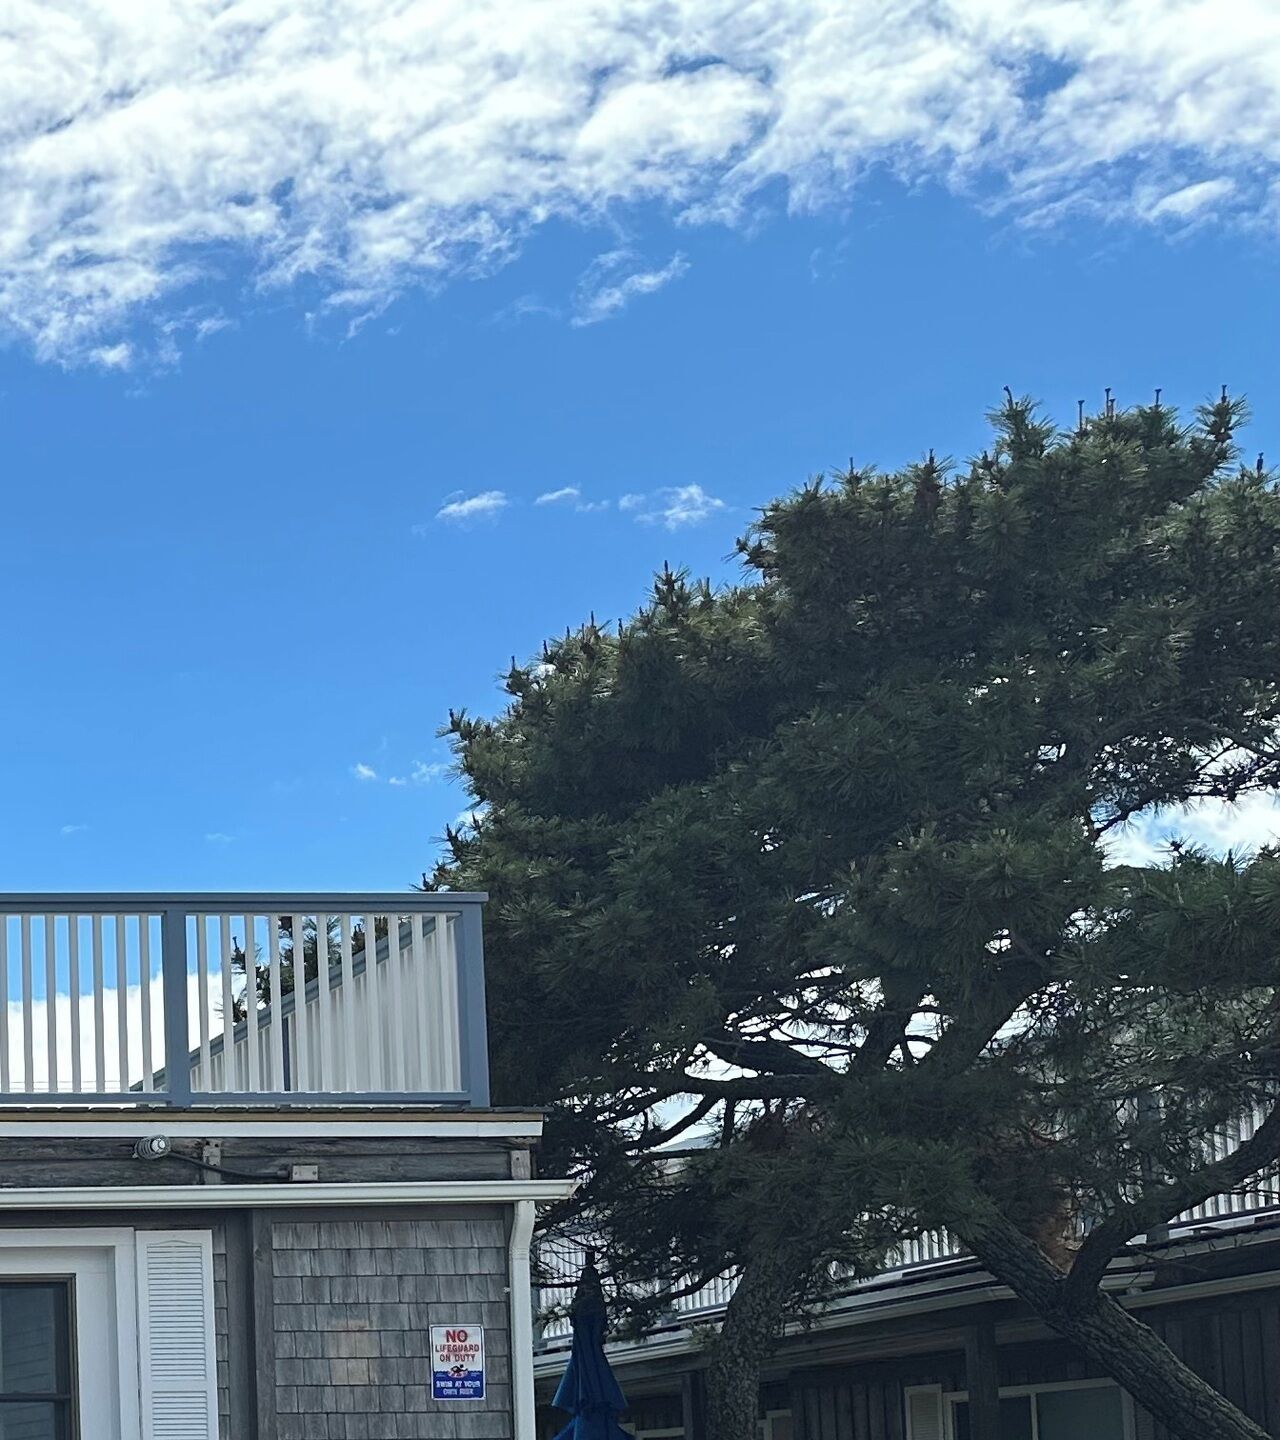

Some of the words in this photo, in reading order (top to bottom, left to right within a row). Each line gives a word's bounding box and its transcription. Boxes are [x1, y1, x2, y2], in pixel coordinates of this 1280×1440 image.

[446, 1330, 468, 1342] NO
[435, 1344, 480, 1352] LIFEGUARD
[440, 1354, 450, 1362] ON
[455, 1354, 476, 1362] DUTY
